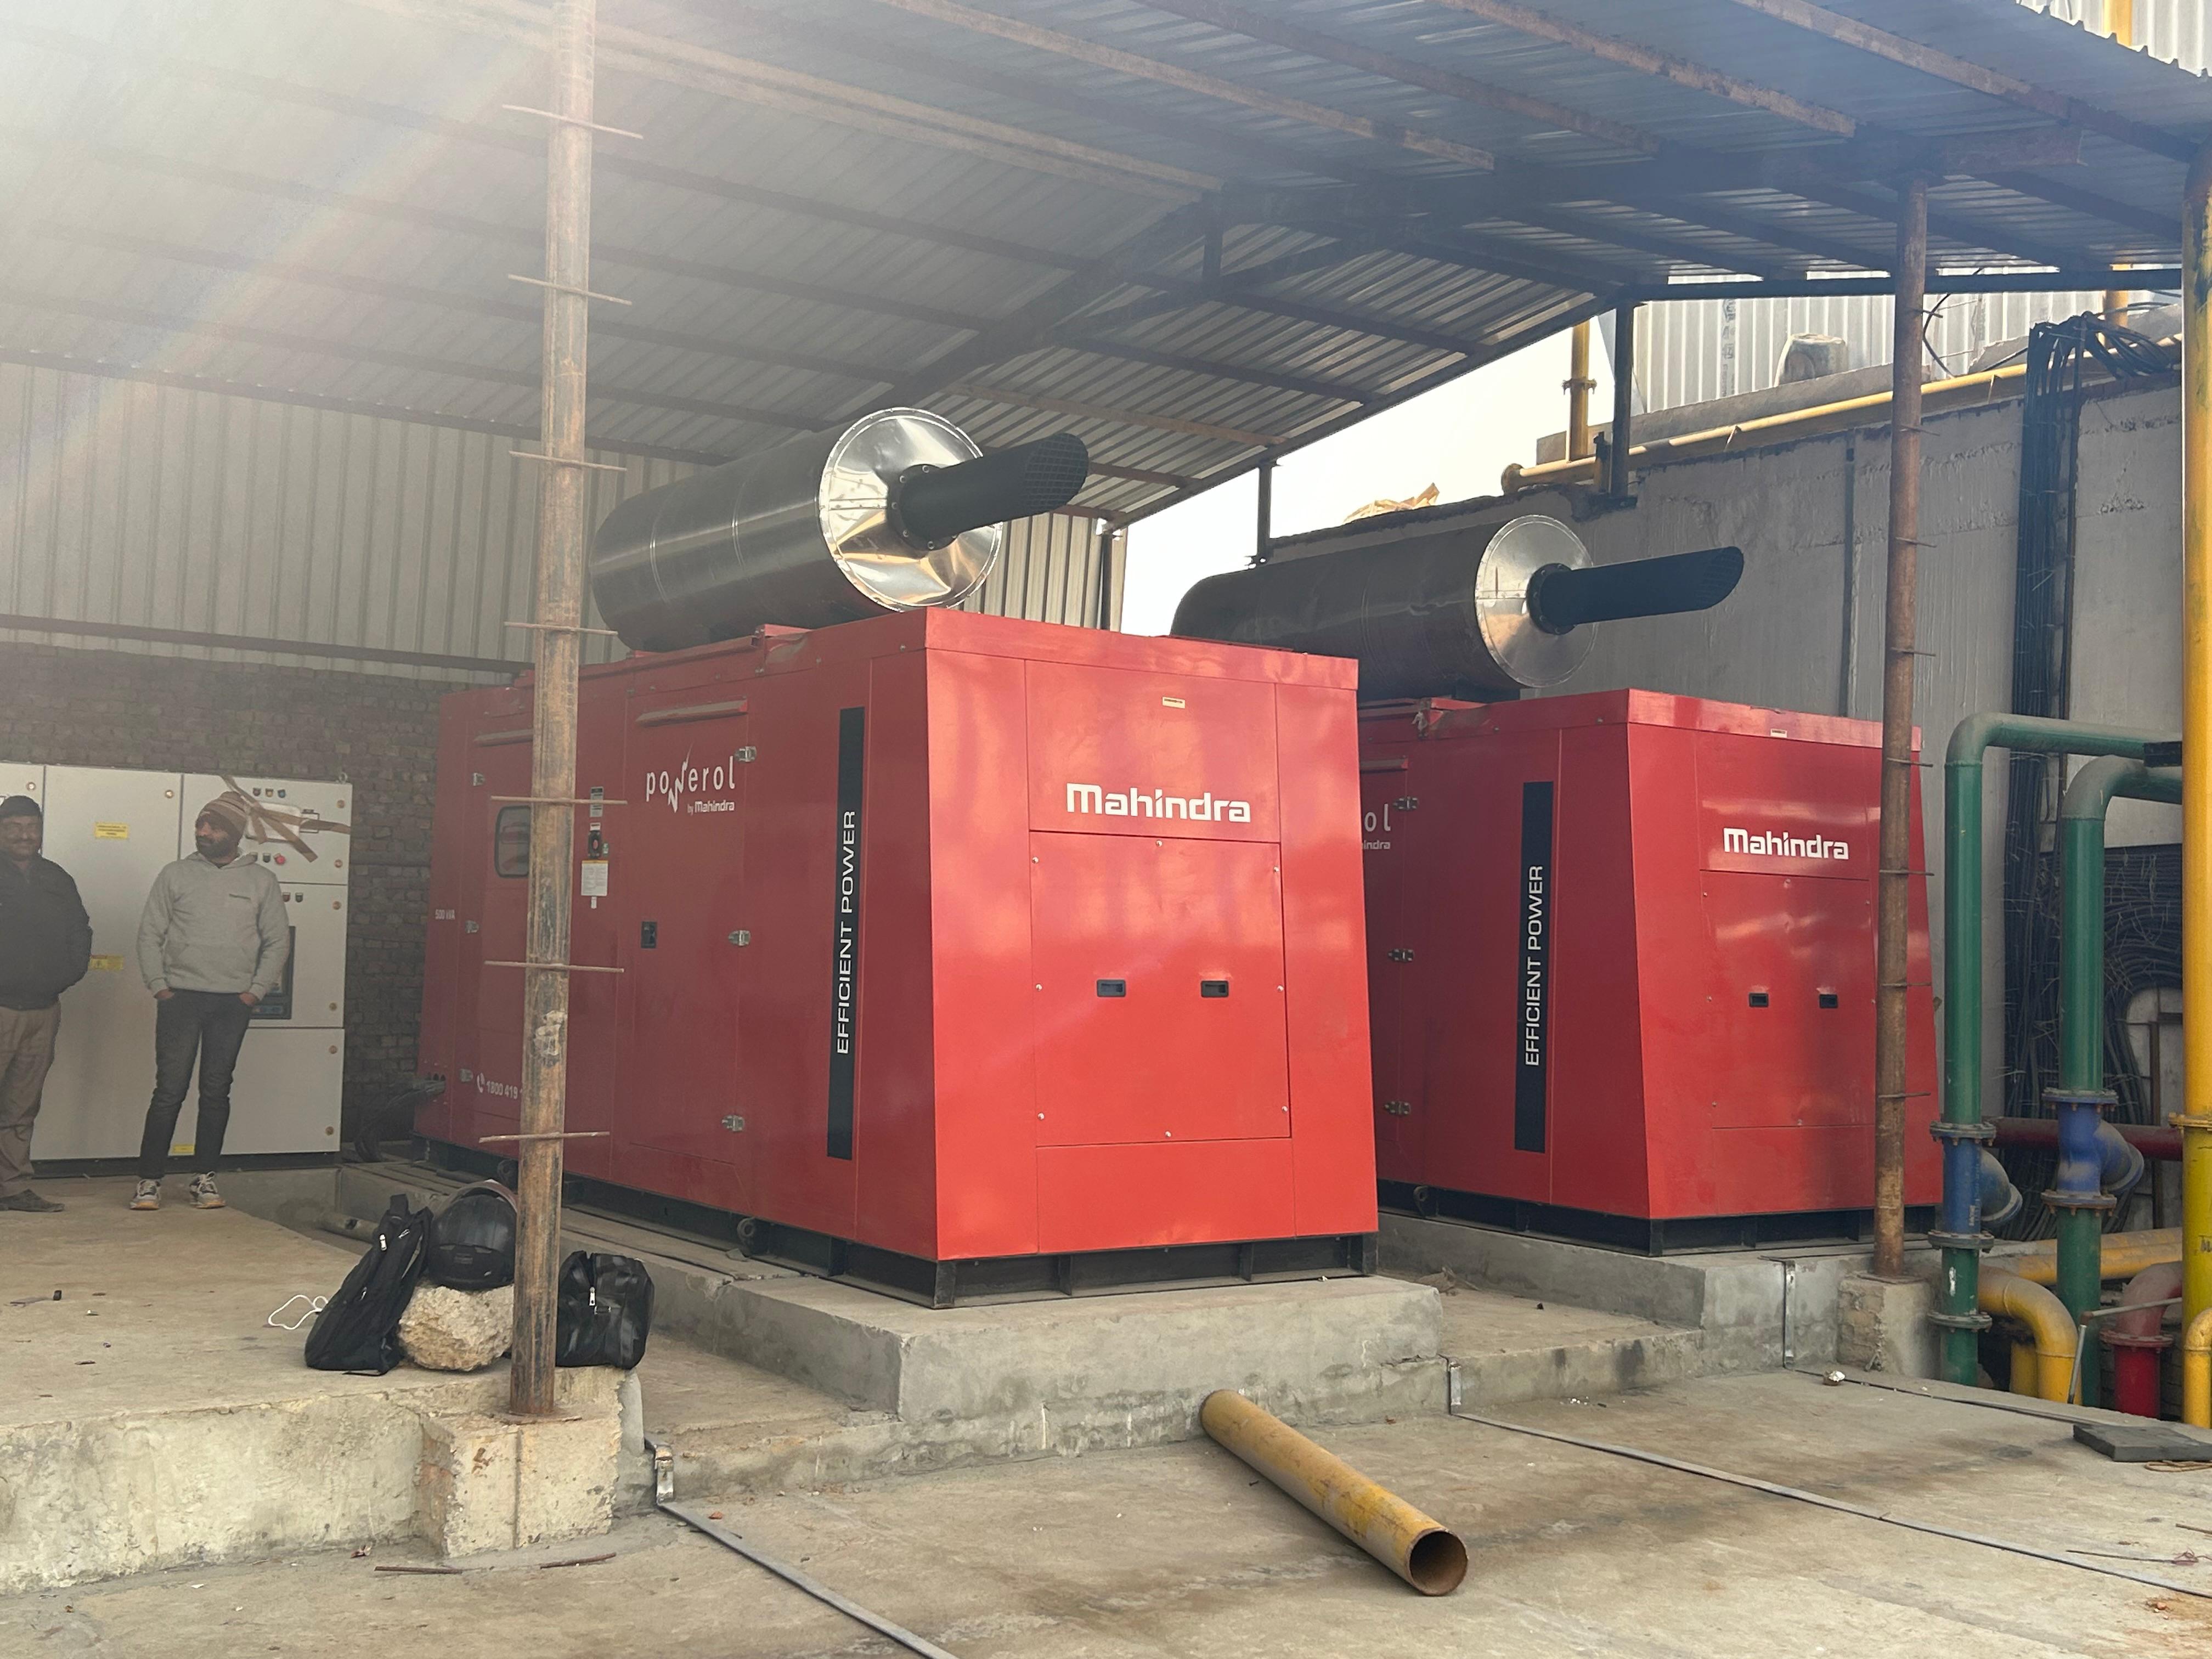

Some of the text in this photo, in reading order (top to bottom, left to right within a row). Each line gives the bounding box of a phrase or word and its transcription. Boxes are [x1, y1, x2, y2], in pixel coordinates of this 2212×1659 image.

[695, 799, 735, 813] Mahindra
[1066, 783, 1251, 822] Mahindra
[1363, 839, 1391, 850] indra
[1723, 827, 1849, 860] Mahindra
[837, 811, 856, 1054] EFFICIENT POWER
[1525, 866, 1543, 1066] EFFICIENT POWER
[504, 1084, 518, 1099] 419
